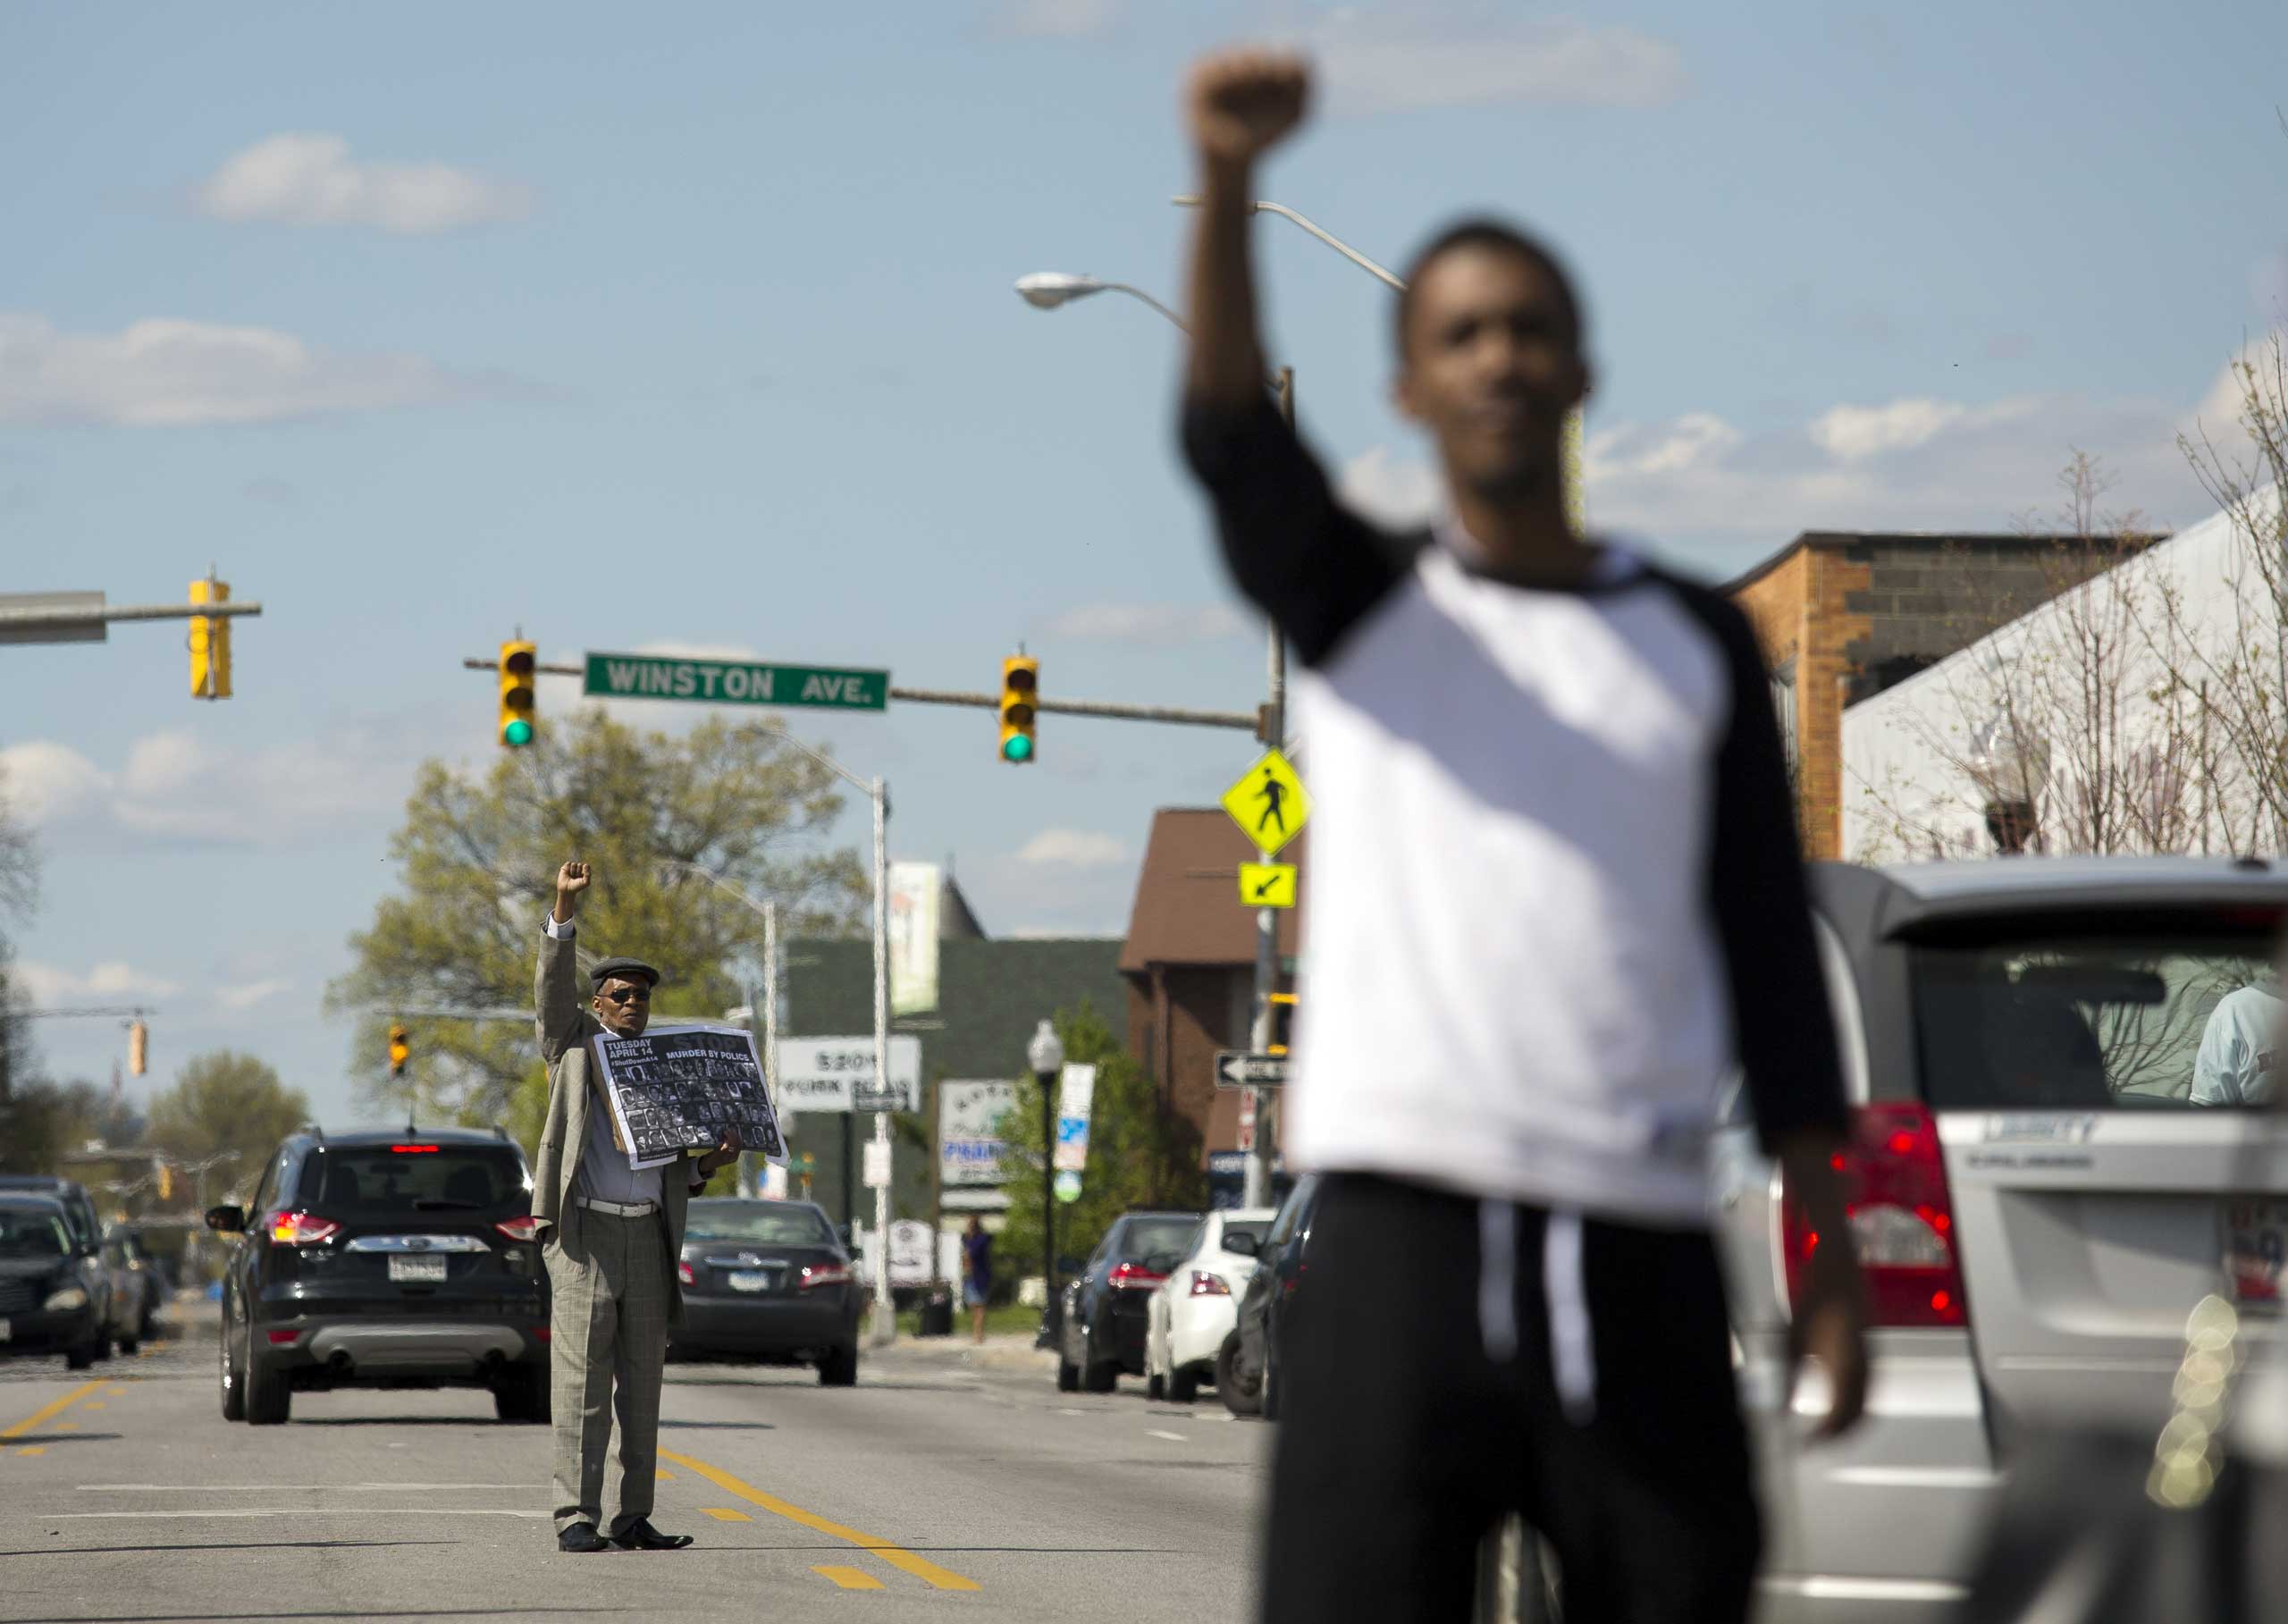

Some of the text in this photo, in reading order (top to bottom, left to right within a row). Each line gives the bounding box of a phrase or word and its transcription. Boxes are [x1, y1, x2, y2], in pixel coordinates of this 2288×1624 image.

[605, 660, 873, 703] WINSTON AVE.
[606, 1039, 652, 1050] TUESDAY
[610, 1046, 653, 1058] APRIL 14
[666, 1048, 749, 1061] MURDER BY POLICE
